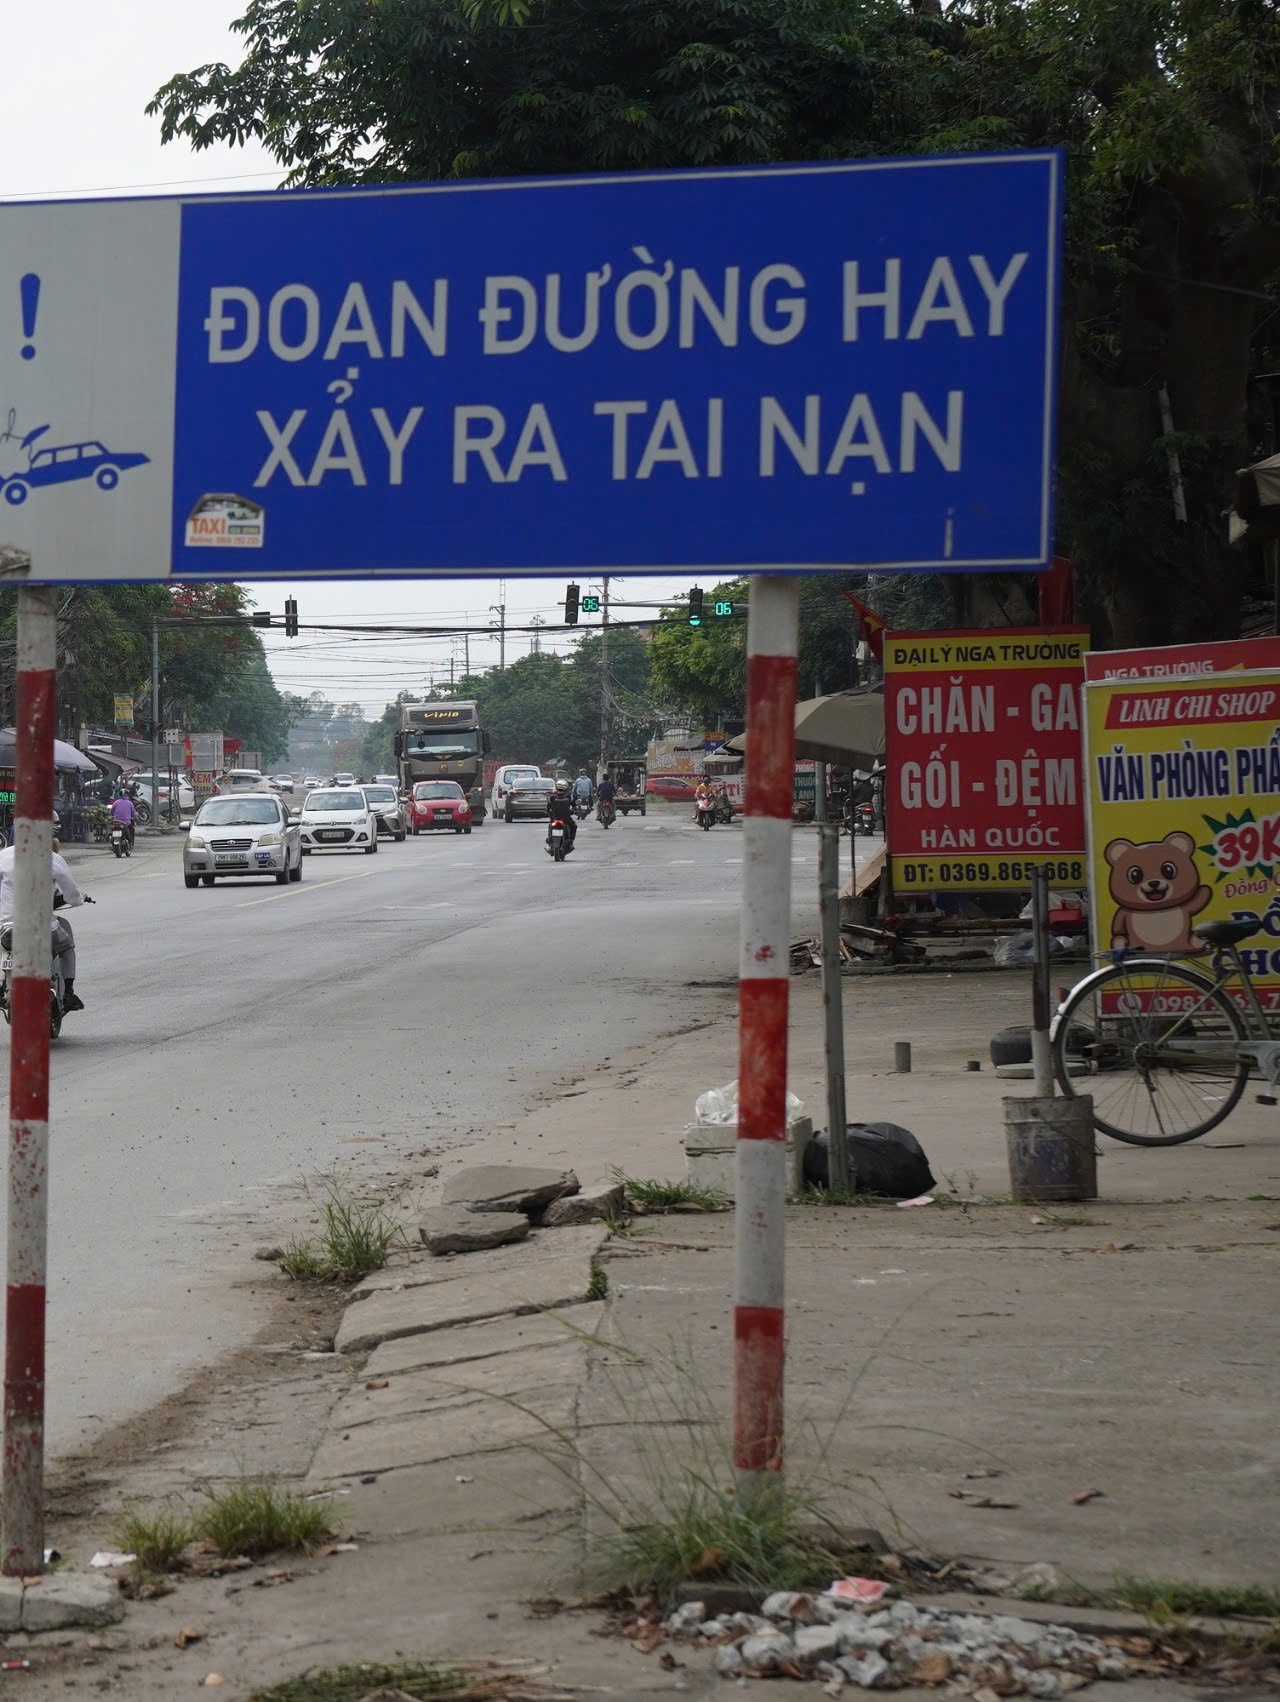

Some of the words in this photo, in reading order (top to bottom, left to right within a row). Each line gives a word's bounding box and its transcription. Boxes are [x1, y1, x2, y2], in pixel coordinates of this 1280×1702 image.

[204, 279, 448, 380] ĐOẠN
[479, 246, 806, 355] ĐƯỜNG
[842, 253, 1029, 342] HAY
[252, 379, 424, 488] XẢY
[453, 402, 568, 484] RA
[593, 398, 723, 480] TAI
[760, 390, 964, 495] NẠN
[192, 517, 226, 534] TAXI
[894, 648, 926, 666] ĐẠI
[930, 643, 951, 663] LÝ
[956, 646, 996, 662] NGA
[896, 675, 995, 735] CHĂN
[1030, 683, 1079, 732] GA
[1120, 696, 1171, 722] LINH
[1174, 694, 1213, 720] CHI
[1215, 690, 1277, 717] SHOP
[191, 771, 210, 783] KEM
[900, 743, 960, 809] GỐI
[994, 748, 1076, 817] ĐỆM
[1097, 746, 1145, 802] VĂN
[1150, 740, 1229, 798] PHÒNG
[1236, 728, 1280, 794] PHẨ
[920, 824, 976, 848] HÀN
[984, 820, 1060, 847] QUỐC
[1218, 818, 1280, 868] 39K
[903, 863, 933, 883] ĐT:
[939, 861, 1082, 882] 0369.865668
[1224, 877, 1268, 898] Đồng
